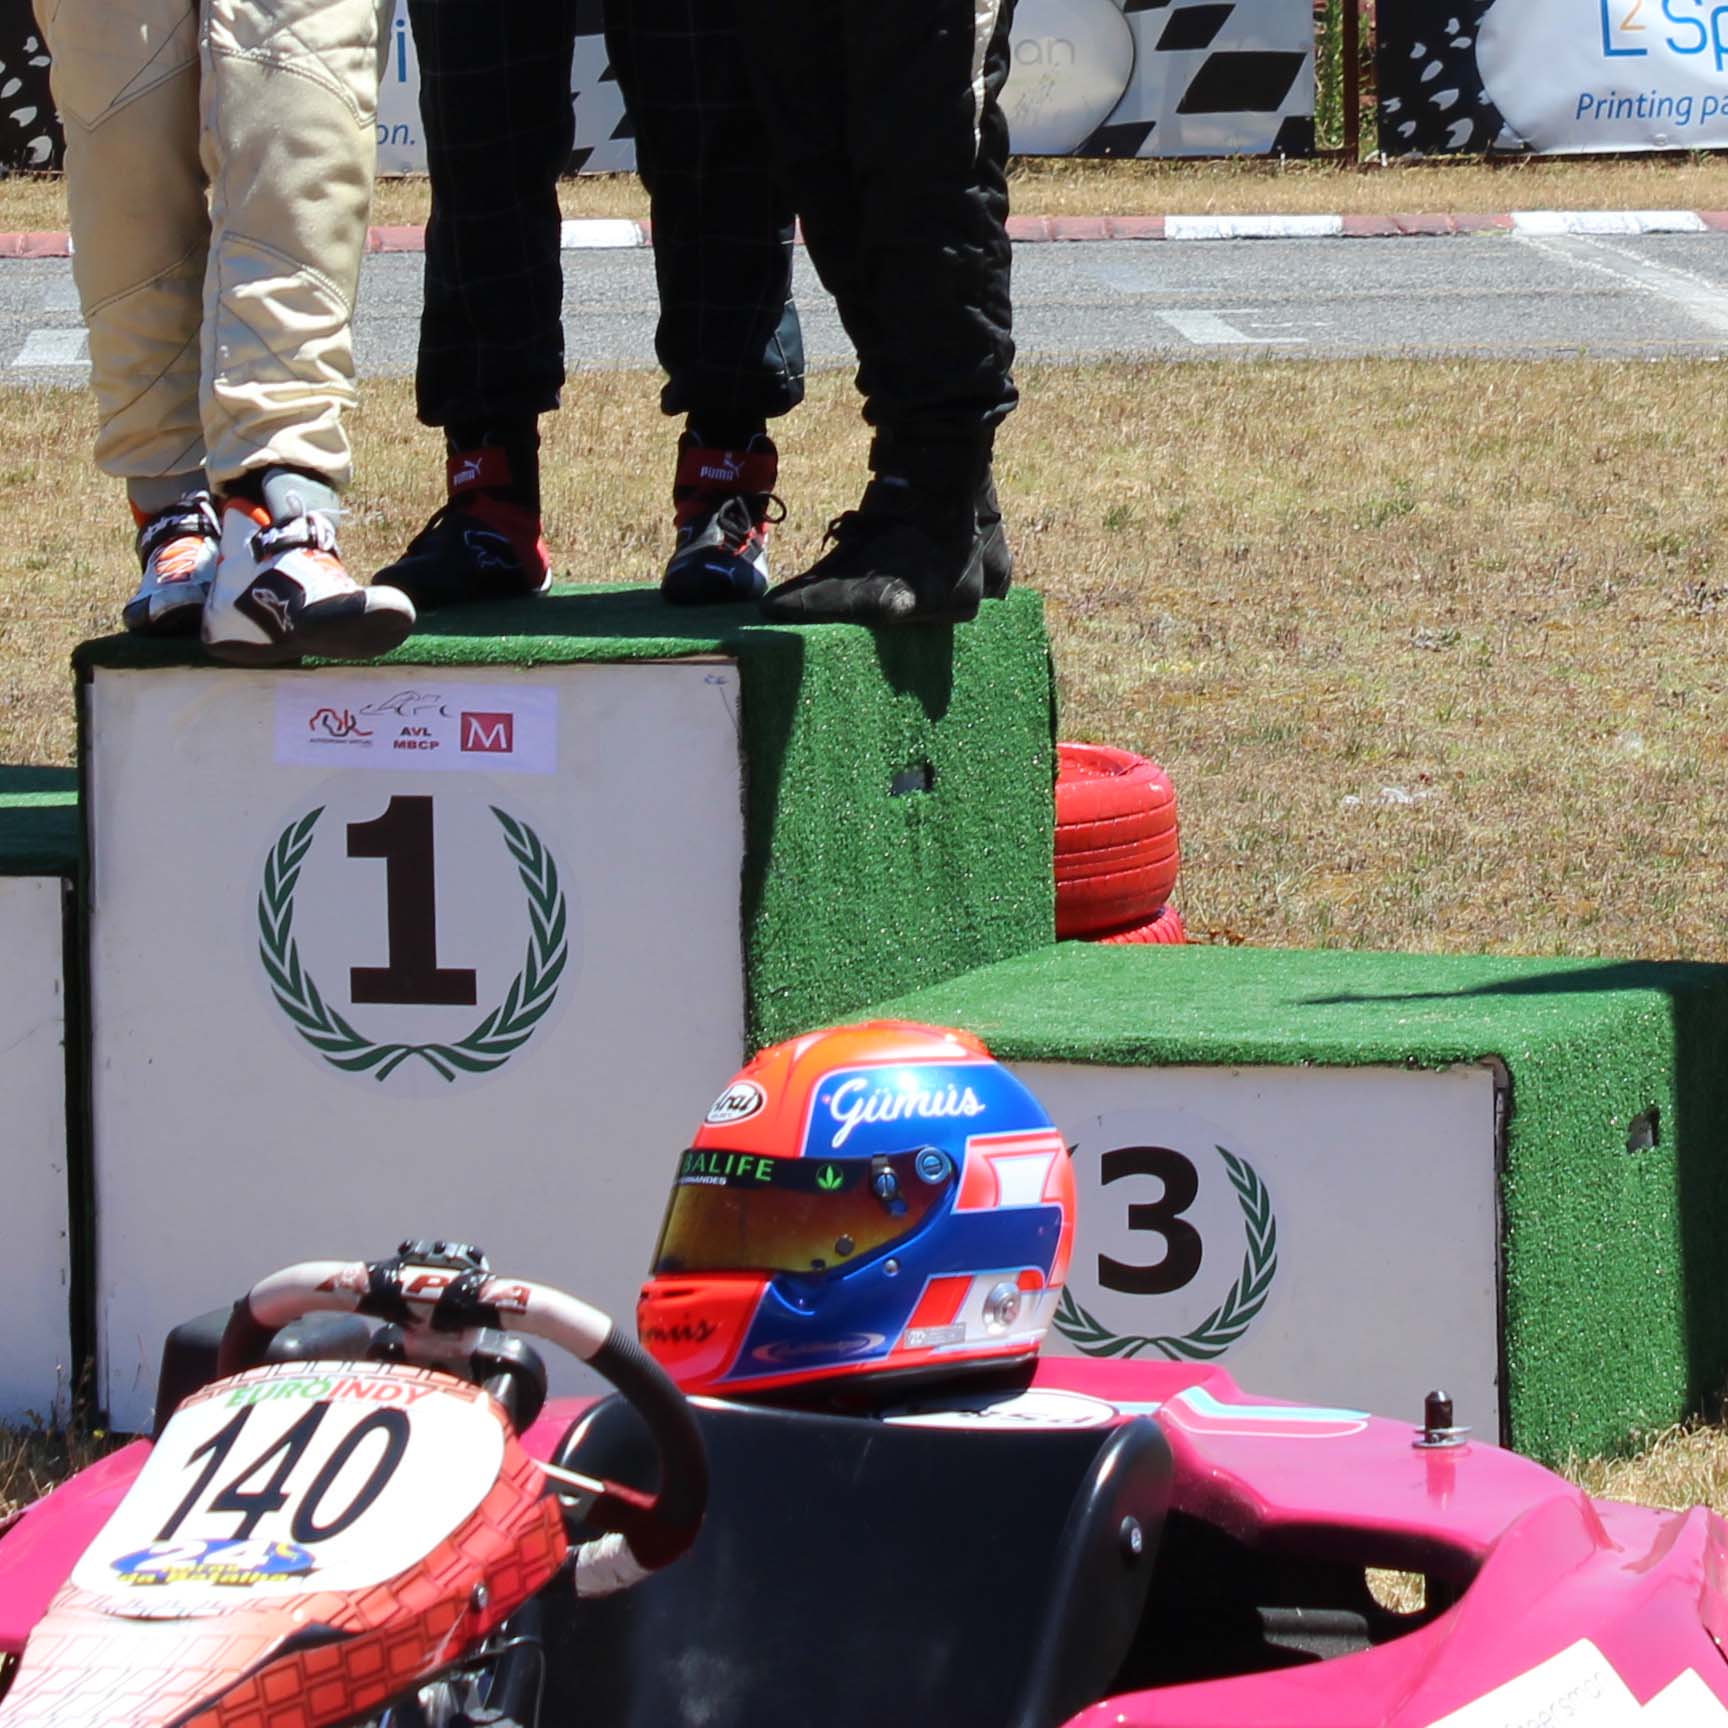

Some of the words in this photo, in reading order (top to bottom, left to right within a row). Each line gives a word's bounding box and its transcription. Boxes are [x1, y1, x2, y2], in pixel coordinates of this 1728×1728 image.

[1575, 91, 1694, 125] Printing
[392, 739, 440, 751] MBCP
[400, 725, 433, 737] AVL
[346, 795, 477, 1007] 1
[1096, 1146, 1204, 1295] 3
[225, 1377, 434, 1408] EUROINDY
[158, 1402, 412, 1544] 140
